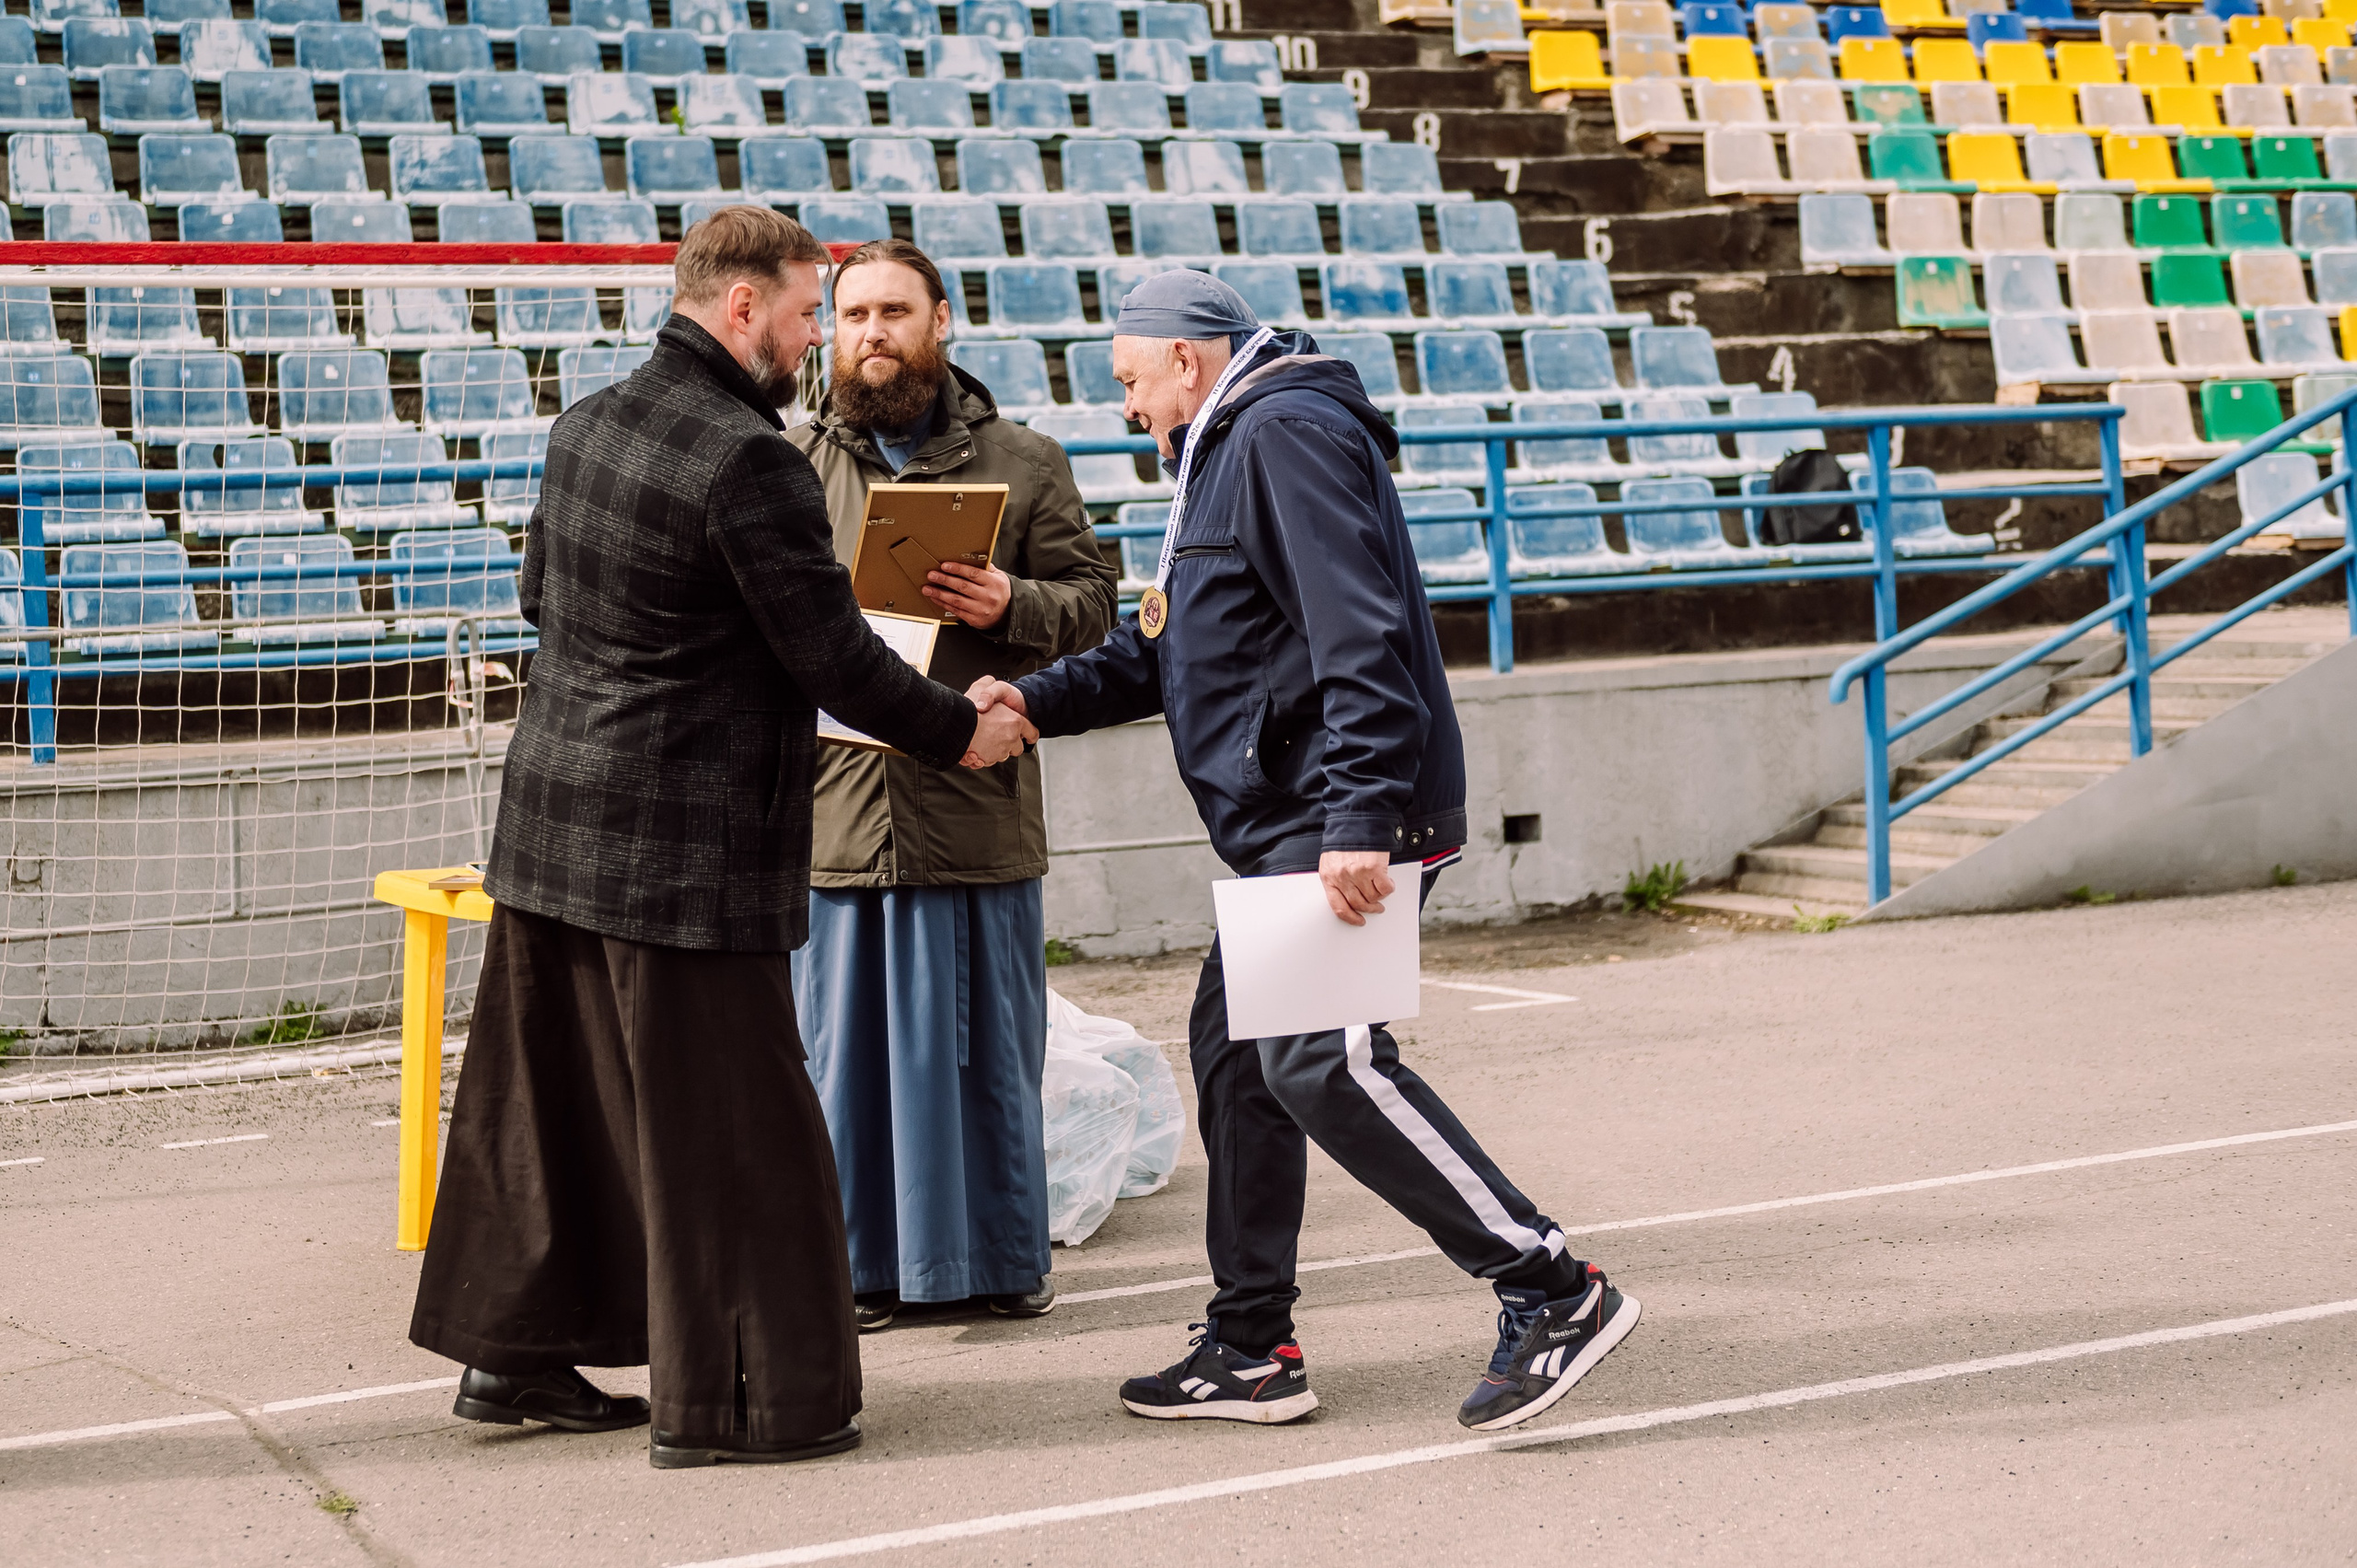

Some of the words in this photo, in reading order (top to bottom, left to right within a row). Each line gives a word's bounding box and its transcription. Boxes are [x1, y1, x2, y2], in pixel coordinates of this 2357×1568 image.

[1212, 0, 1242, 31] 11
[1271, 34, 1318, 71] 10
[1342, 69, 1370, 110] 9
[1412, 112, 1441, 153] 8
[1494, 158, 1521, 194] 7
[1584, 217, 1613, 263] 6
[1668, 291, 1697, 328] 5
[1766, 345, 1796, 393] 4
[1501, 1294, 1526, 1303] Reebok
[1549, 1327, 1581, 1340] Reebok
